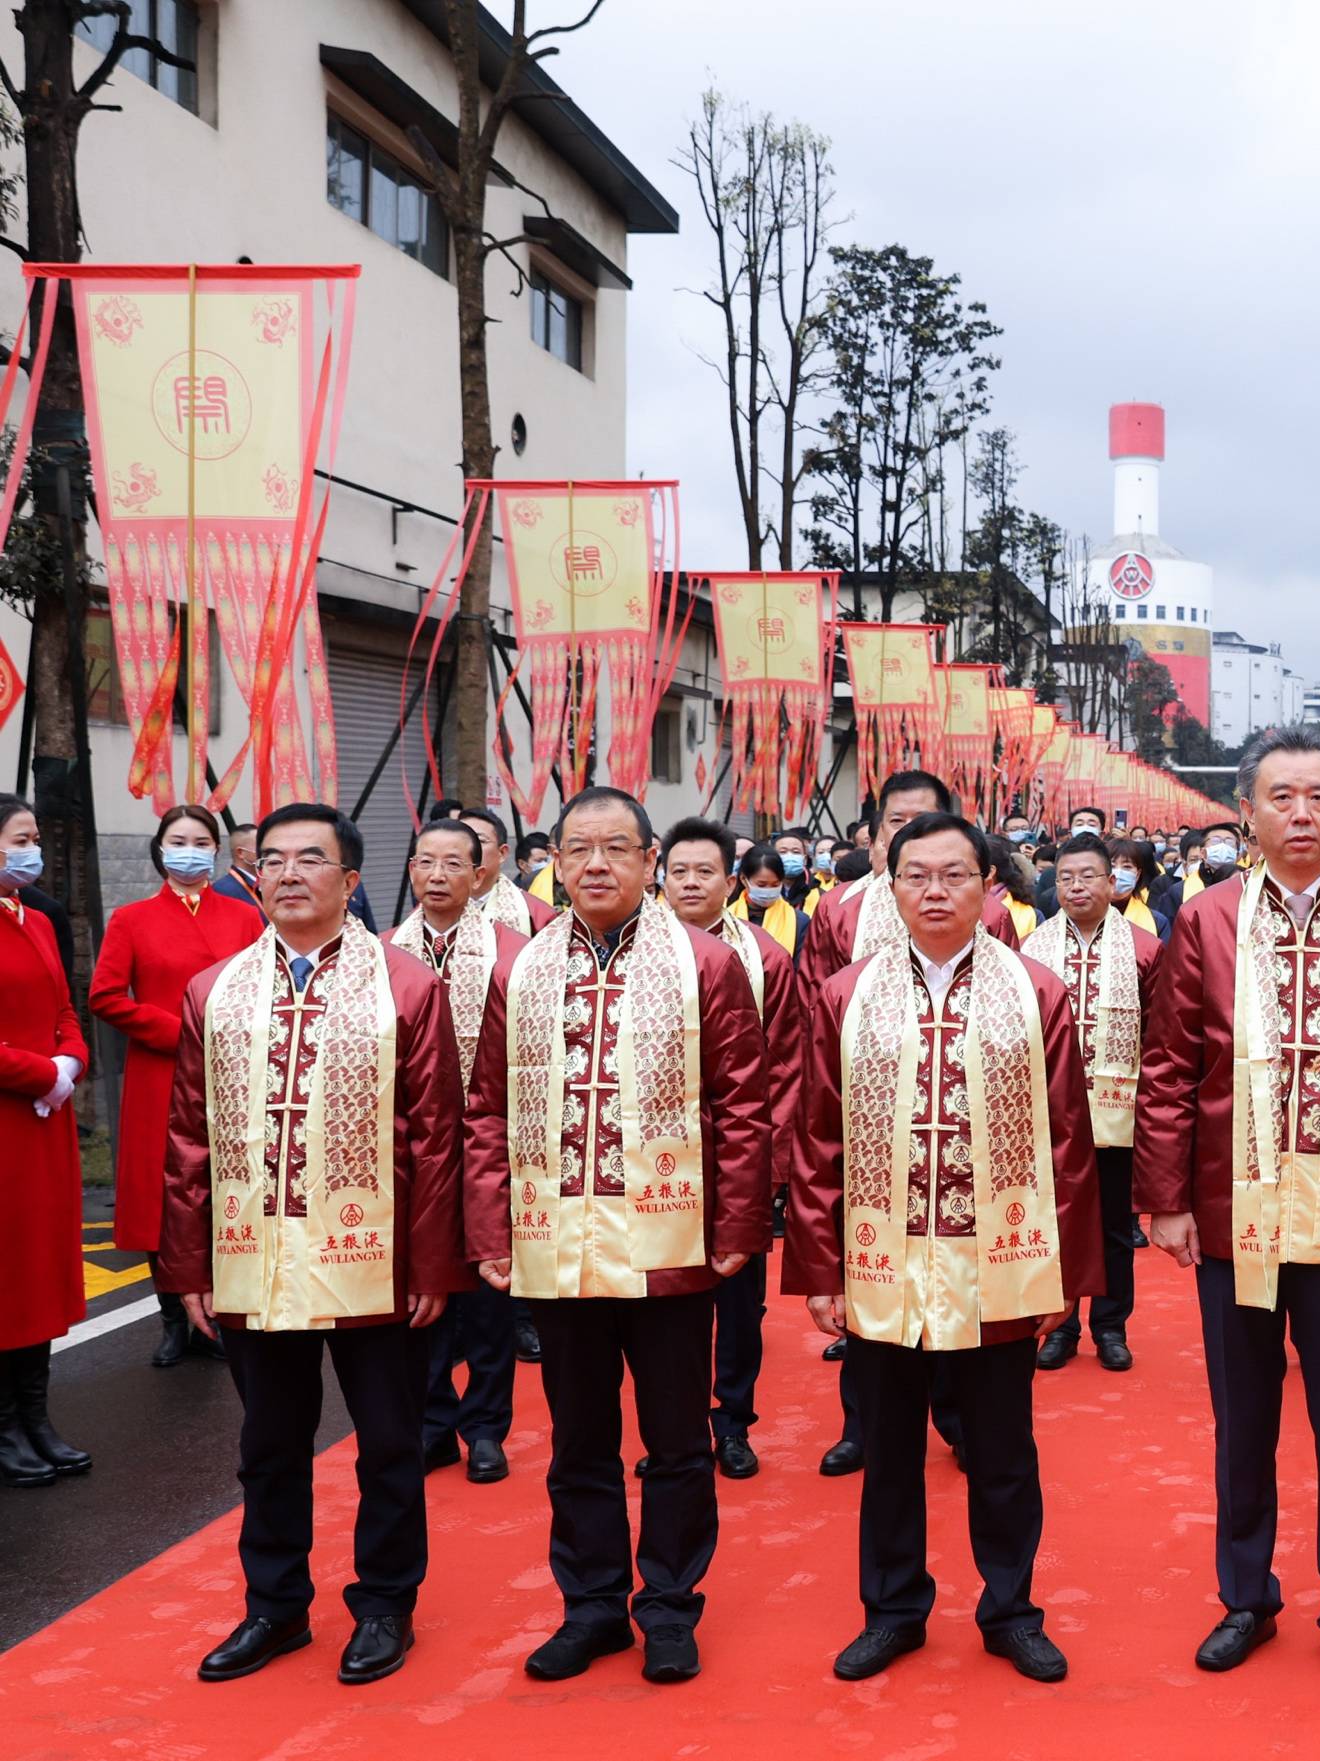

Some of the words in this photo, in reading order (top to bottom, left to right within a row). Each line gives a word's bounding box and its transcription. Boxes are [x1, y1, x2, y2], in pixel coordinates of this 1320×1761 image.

[636, 1180, 697, 1202] 五粮液
[635, 1200, 699, 1214] WULIANGYE
[320, 1231, 385, 1251] 五粮液
[988, 1228, 1048, 1252] 五粮液
[319, 1251, 386, 1265] WULIANGYE
[988, 1247, 1051, 1264] WULIANGYE
